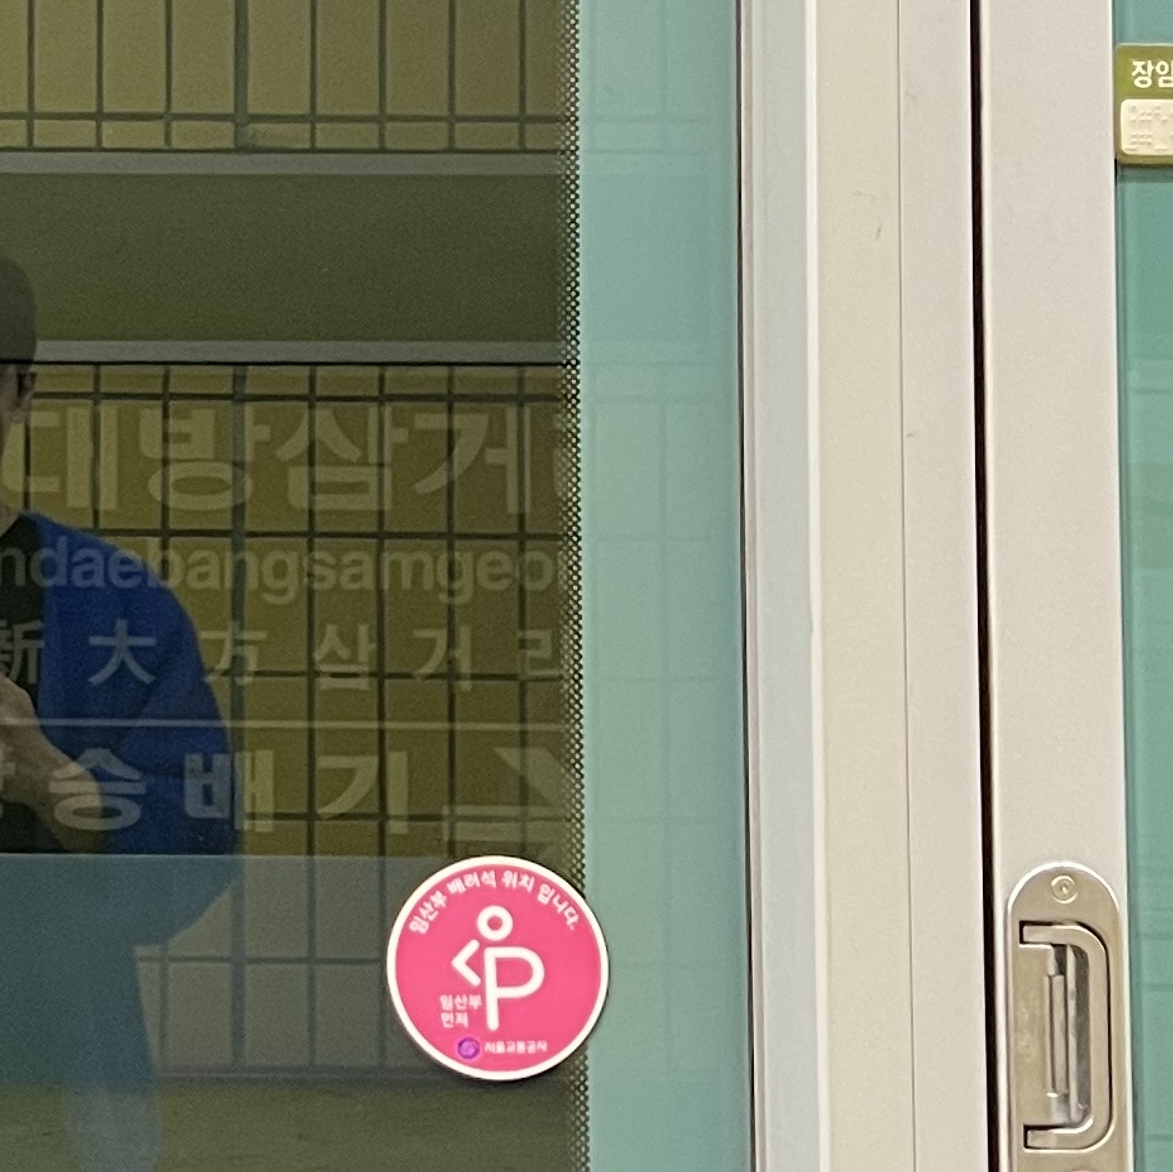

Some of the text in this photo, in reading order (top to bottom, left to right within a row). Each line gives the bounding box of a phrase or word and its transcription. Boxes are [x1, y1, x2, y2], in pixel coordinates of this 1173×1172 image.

[408, 890, 448, 934] 임산부
[446, 870, 497, 895] 배려석
[439, 994, 483, 1011] 임산부
[440, 1011, 469, 1029] 먼저
